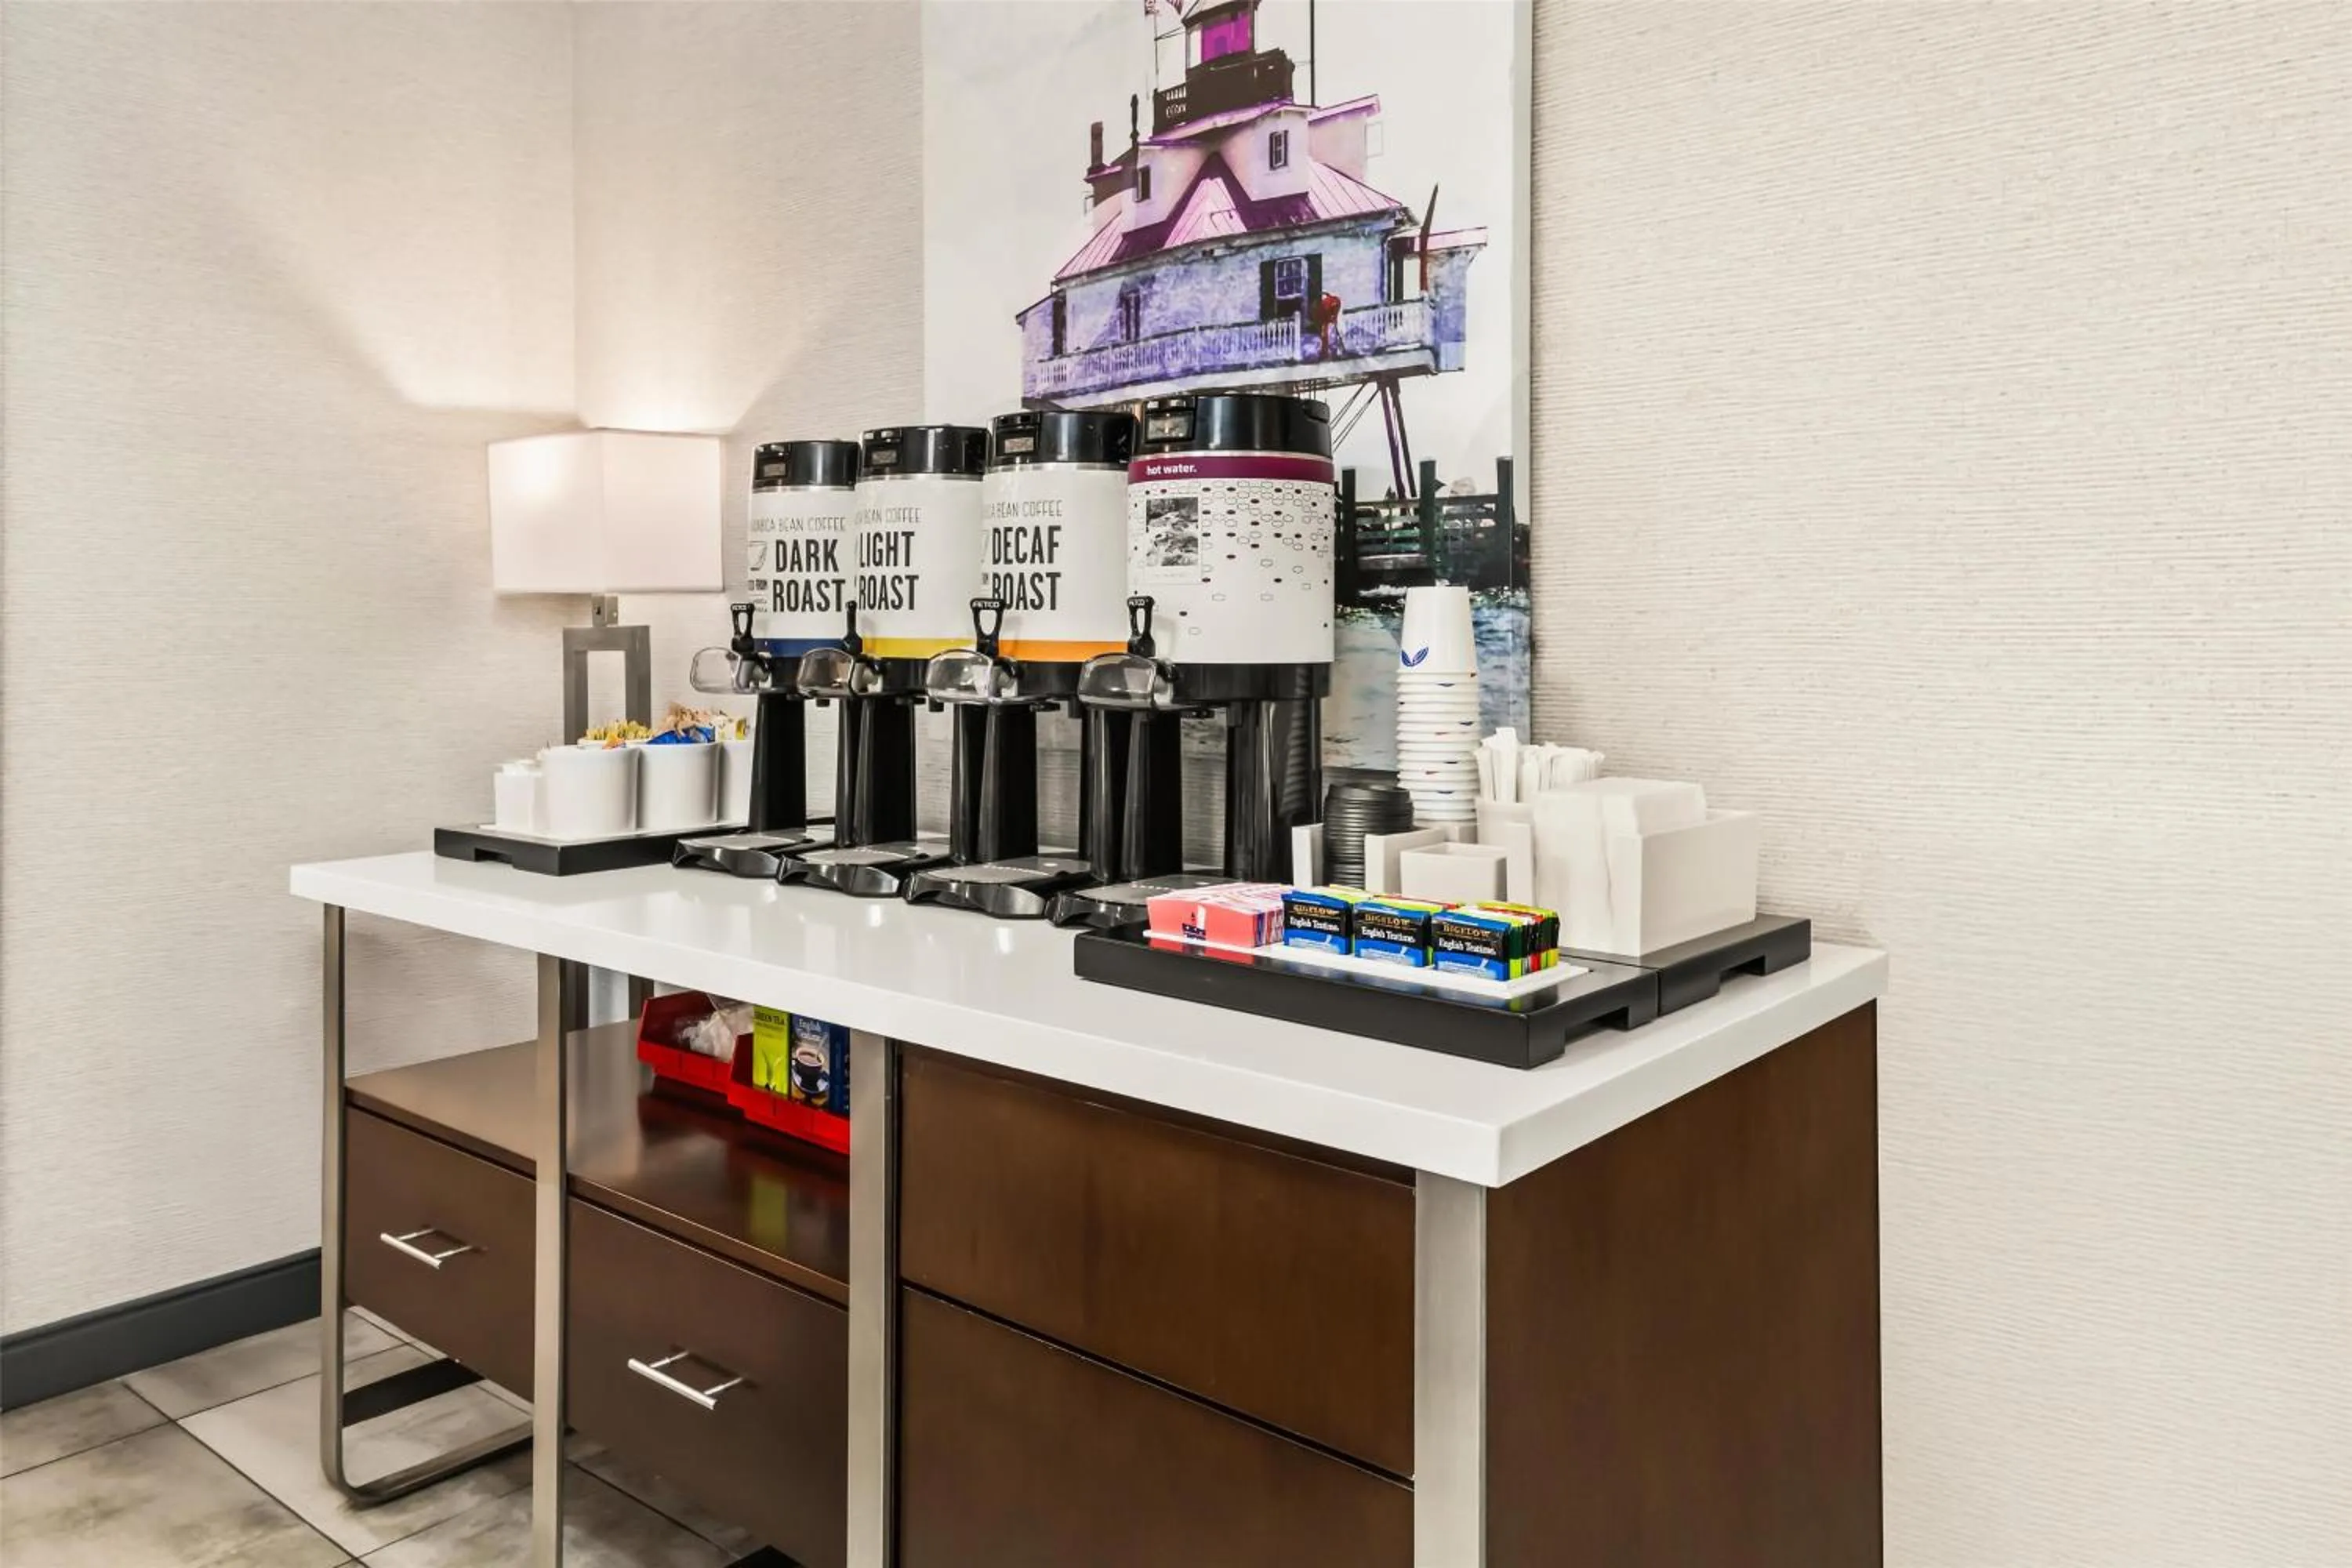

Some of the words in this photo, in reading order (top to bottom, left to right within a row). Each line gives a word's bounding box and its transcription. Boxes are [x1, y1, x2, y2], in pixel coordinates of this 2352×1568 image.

[1146, 465, 1161, 476] hot
[1022, 499, 1062, 517] COFFEE
[779, 517, 804, 532] BEAN
[808, 516, 847, 532] COFFEE
[860, 531, 915, 568] LIGHT
[992, 525, 1062, 564] DECAF
[775, 539, 839, 572] DARK
[772, 579, 846, 612] ROAST
[859, 575, 919, 611] ROAST
[992, 572, 1062, 611] ROAST
[1290, 916, 1312, 928] English
[1443, 923, 1491, 938] BIGELOW
[1361, 926, 1385, 939] English
[1439, 937, 1465, 950] English
